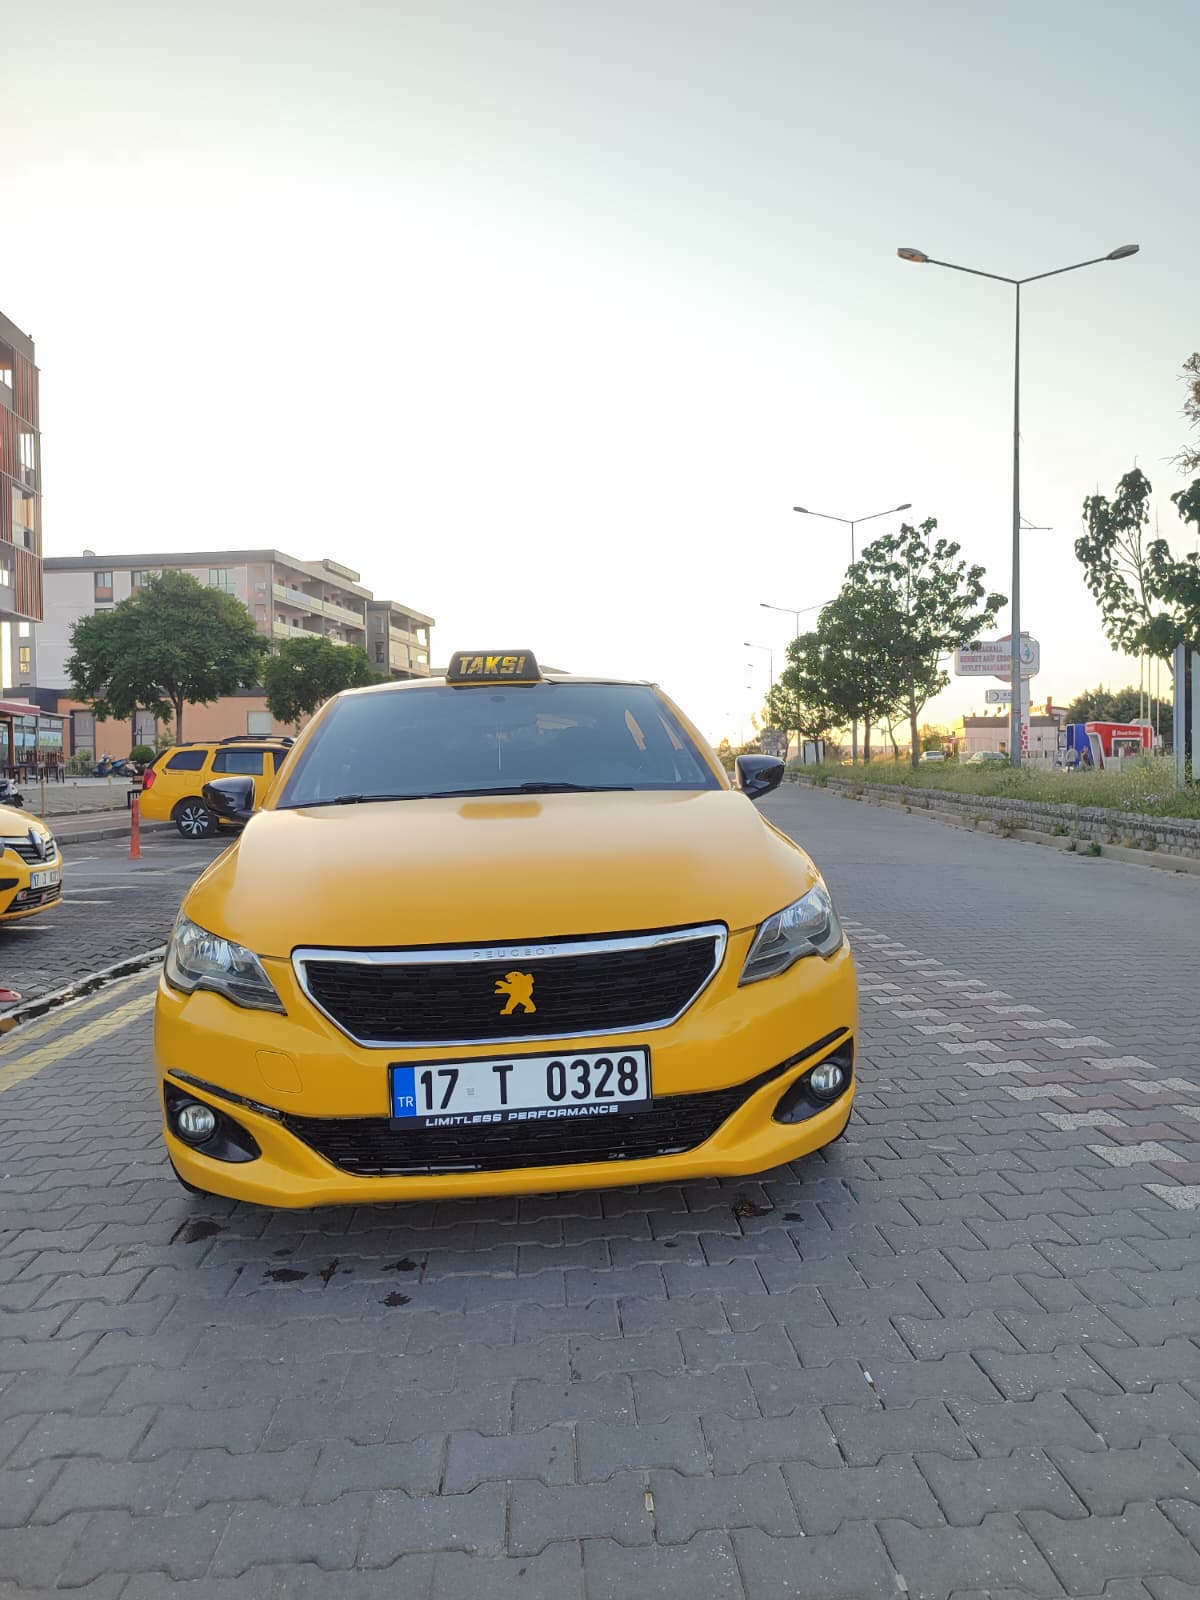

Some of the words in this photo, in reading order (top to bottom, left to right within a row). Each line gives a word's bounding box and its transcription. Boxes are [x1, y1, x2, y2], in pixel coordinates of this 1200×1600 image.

[459, 655, 527, 675] TAKSI
[473, 946, 557, 958] PEUGEOT
[397, 1096, 415, 1108] TR
[420, 1068, 459, 1110] 17
[492, 1064, 514, 1105] T
[546, 1055, 639, 1102] 0328
[425, 1113, 502, 1127] LIMITLESS
[507, 1104, 619, 1121] PERFORMANCE
